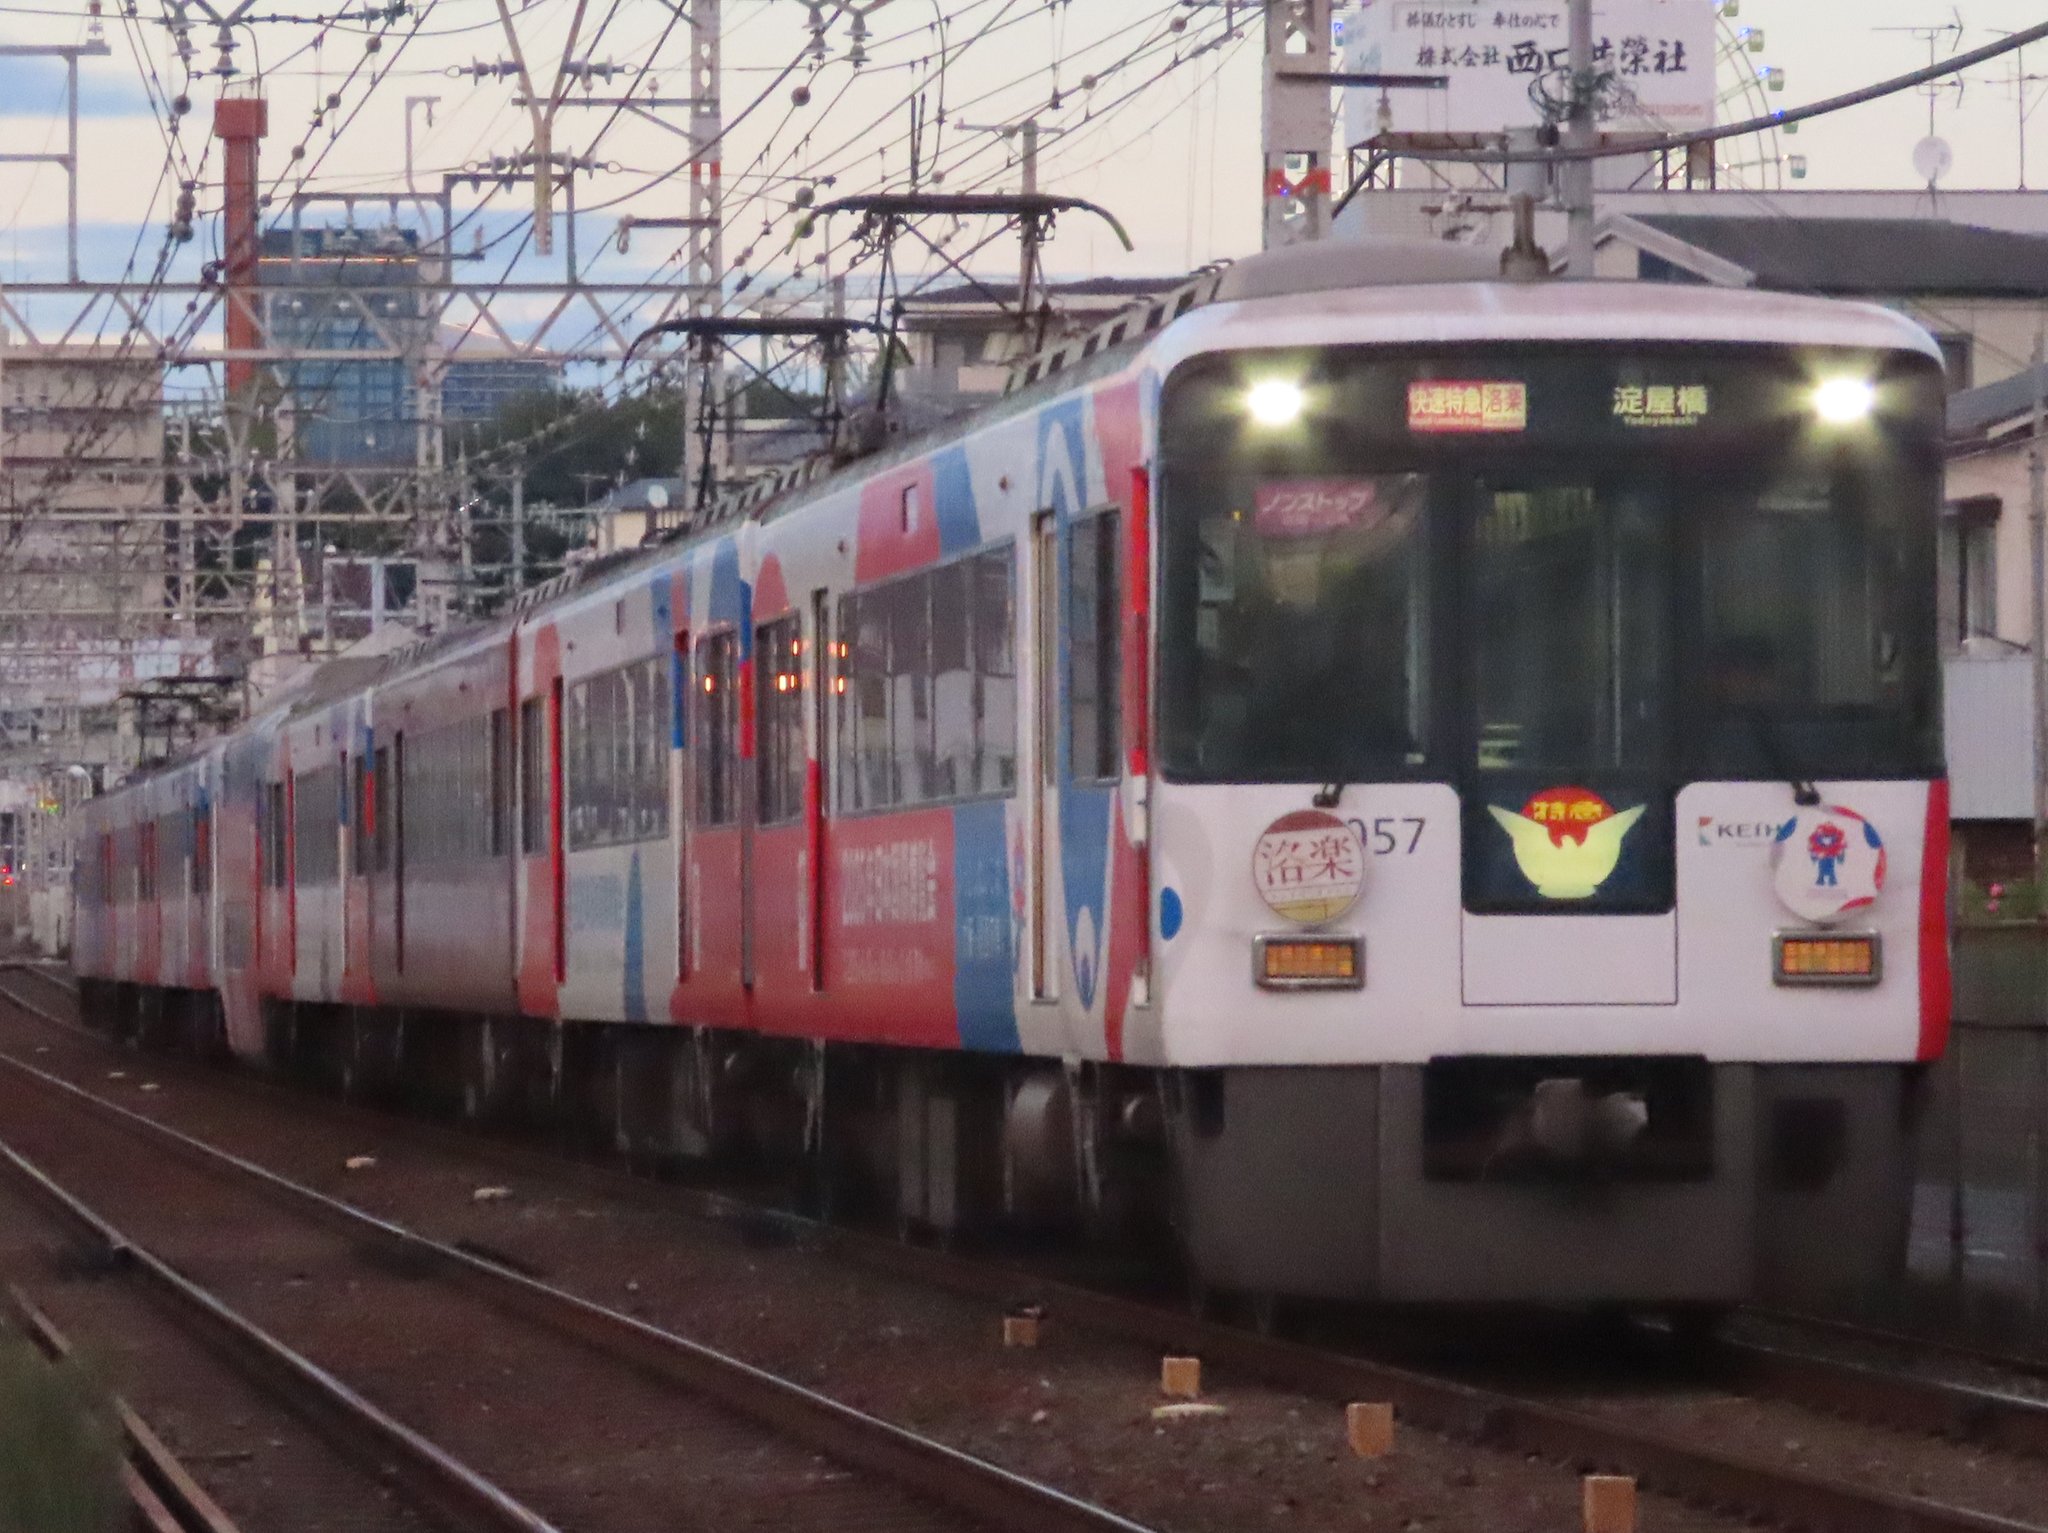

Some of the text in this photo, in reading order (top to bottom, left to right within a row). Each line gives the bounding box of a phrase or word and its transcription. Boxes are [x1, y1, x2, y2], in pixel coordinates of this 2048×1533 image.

[1416, 45, 1500, 67] 株式会社
[1613, 385, 1708, 415] 淀屋橋
[1260, 835, 1353, 886] 洛楽
